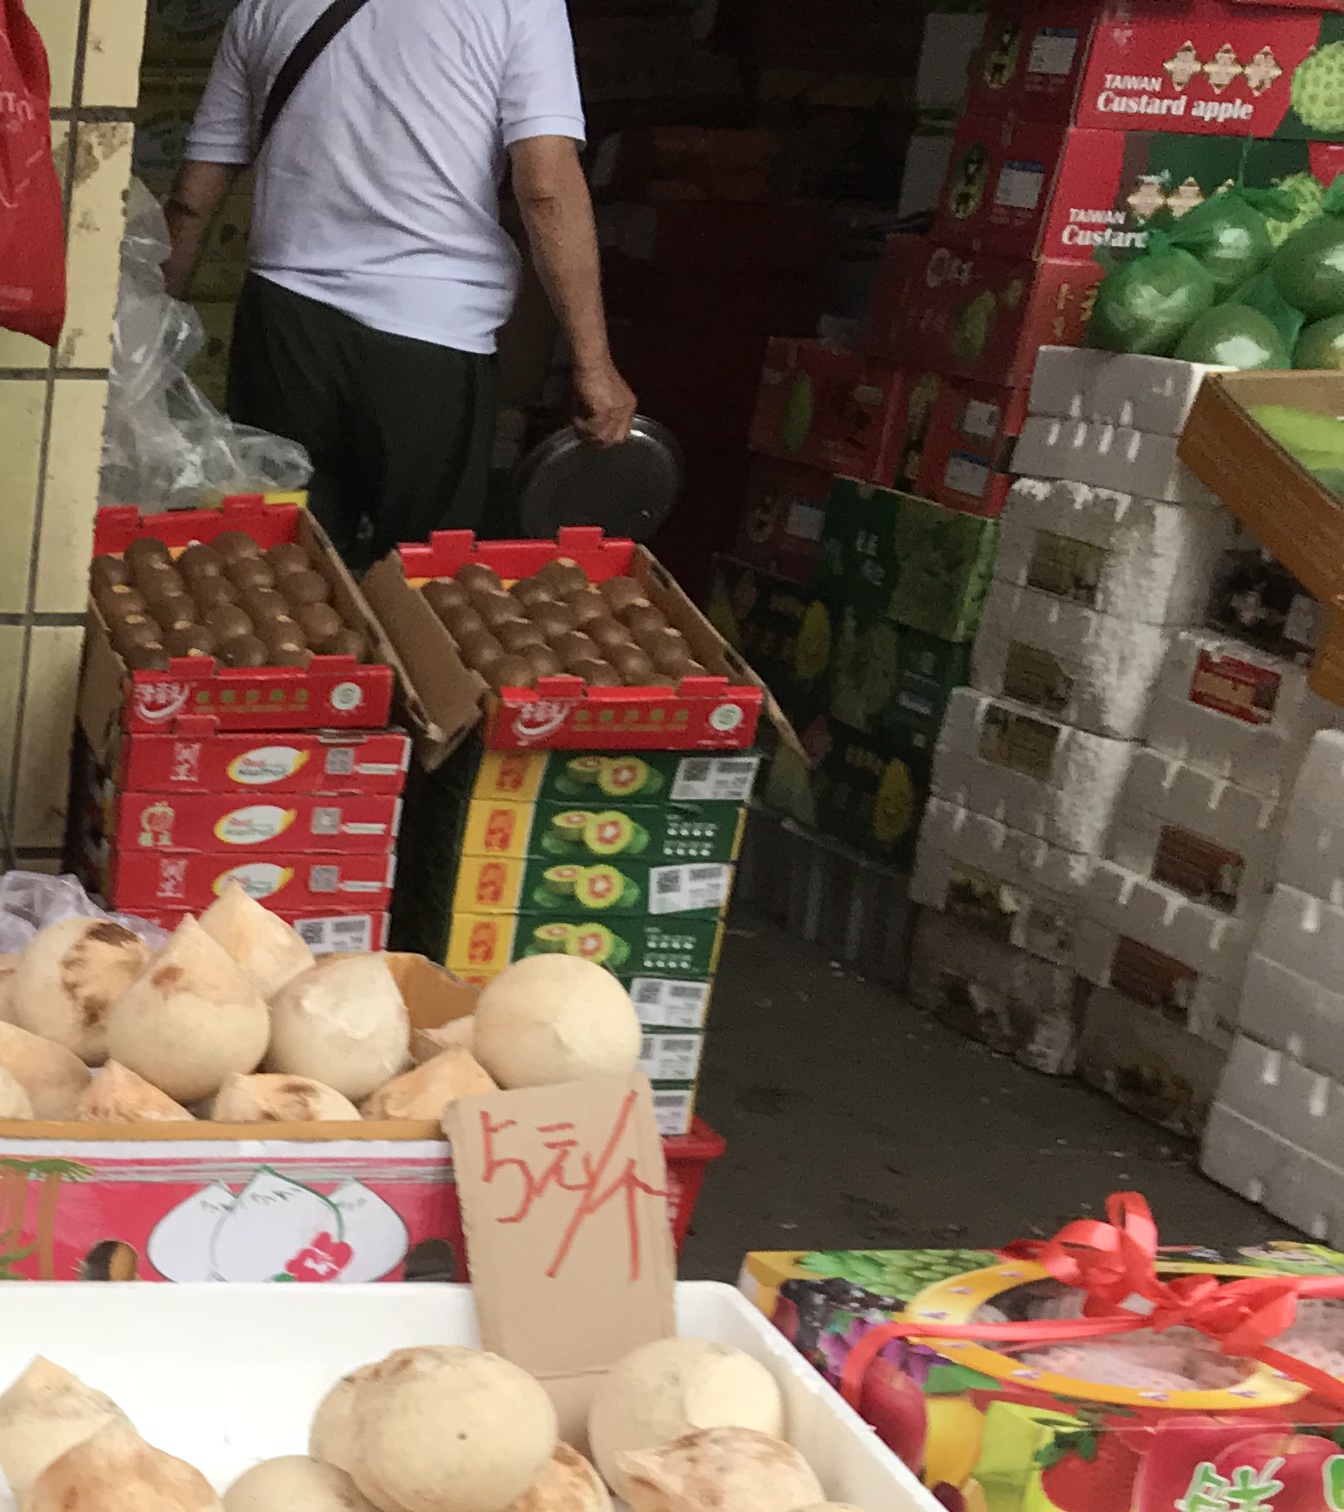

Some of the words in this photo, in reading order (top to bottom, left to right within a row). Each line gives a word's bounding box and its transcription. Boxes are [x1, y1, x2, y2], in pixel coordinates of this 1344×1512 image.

[1105, 75, 1162, 92] TAIWAN
[1097, 91, 1188, 116] Custard
[1191, 98, 1254, 123] apple
